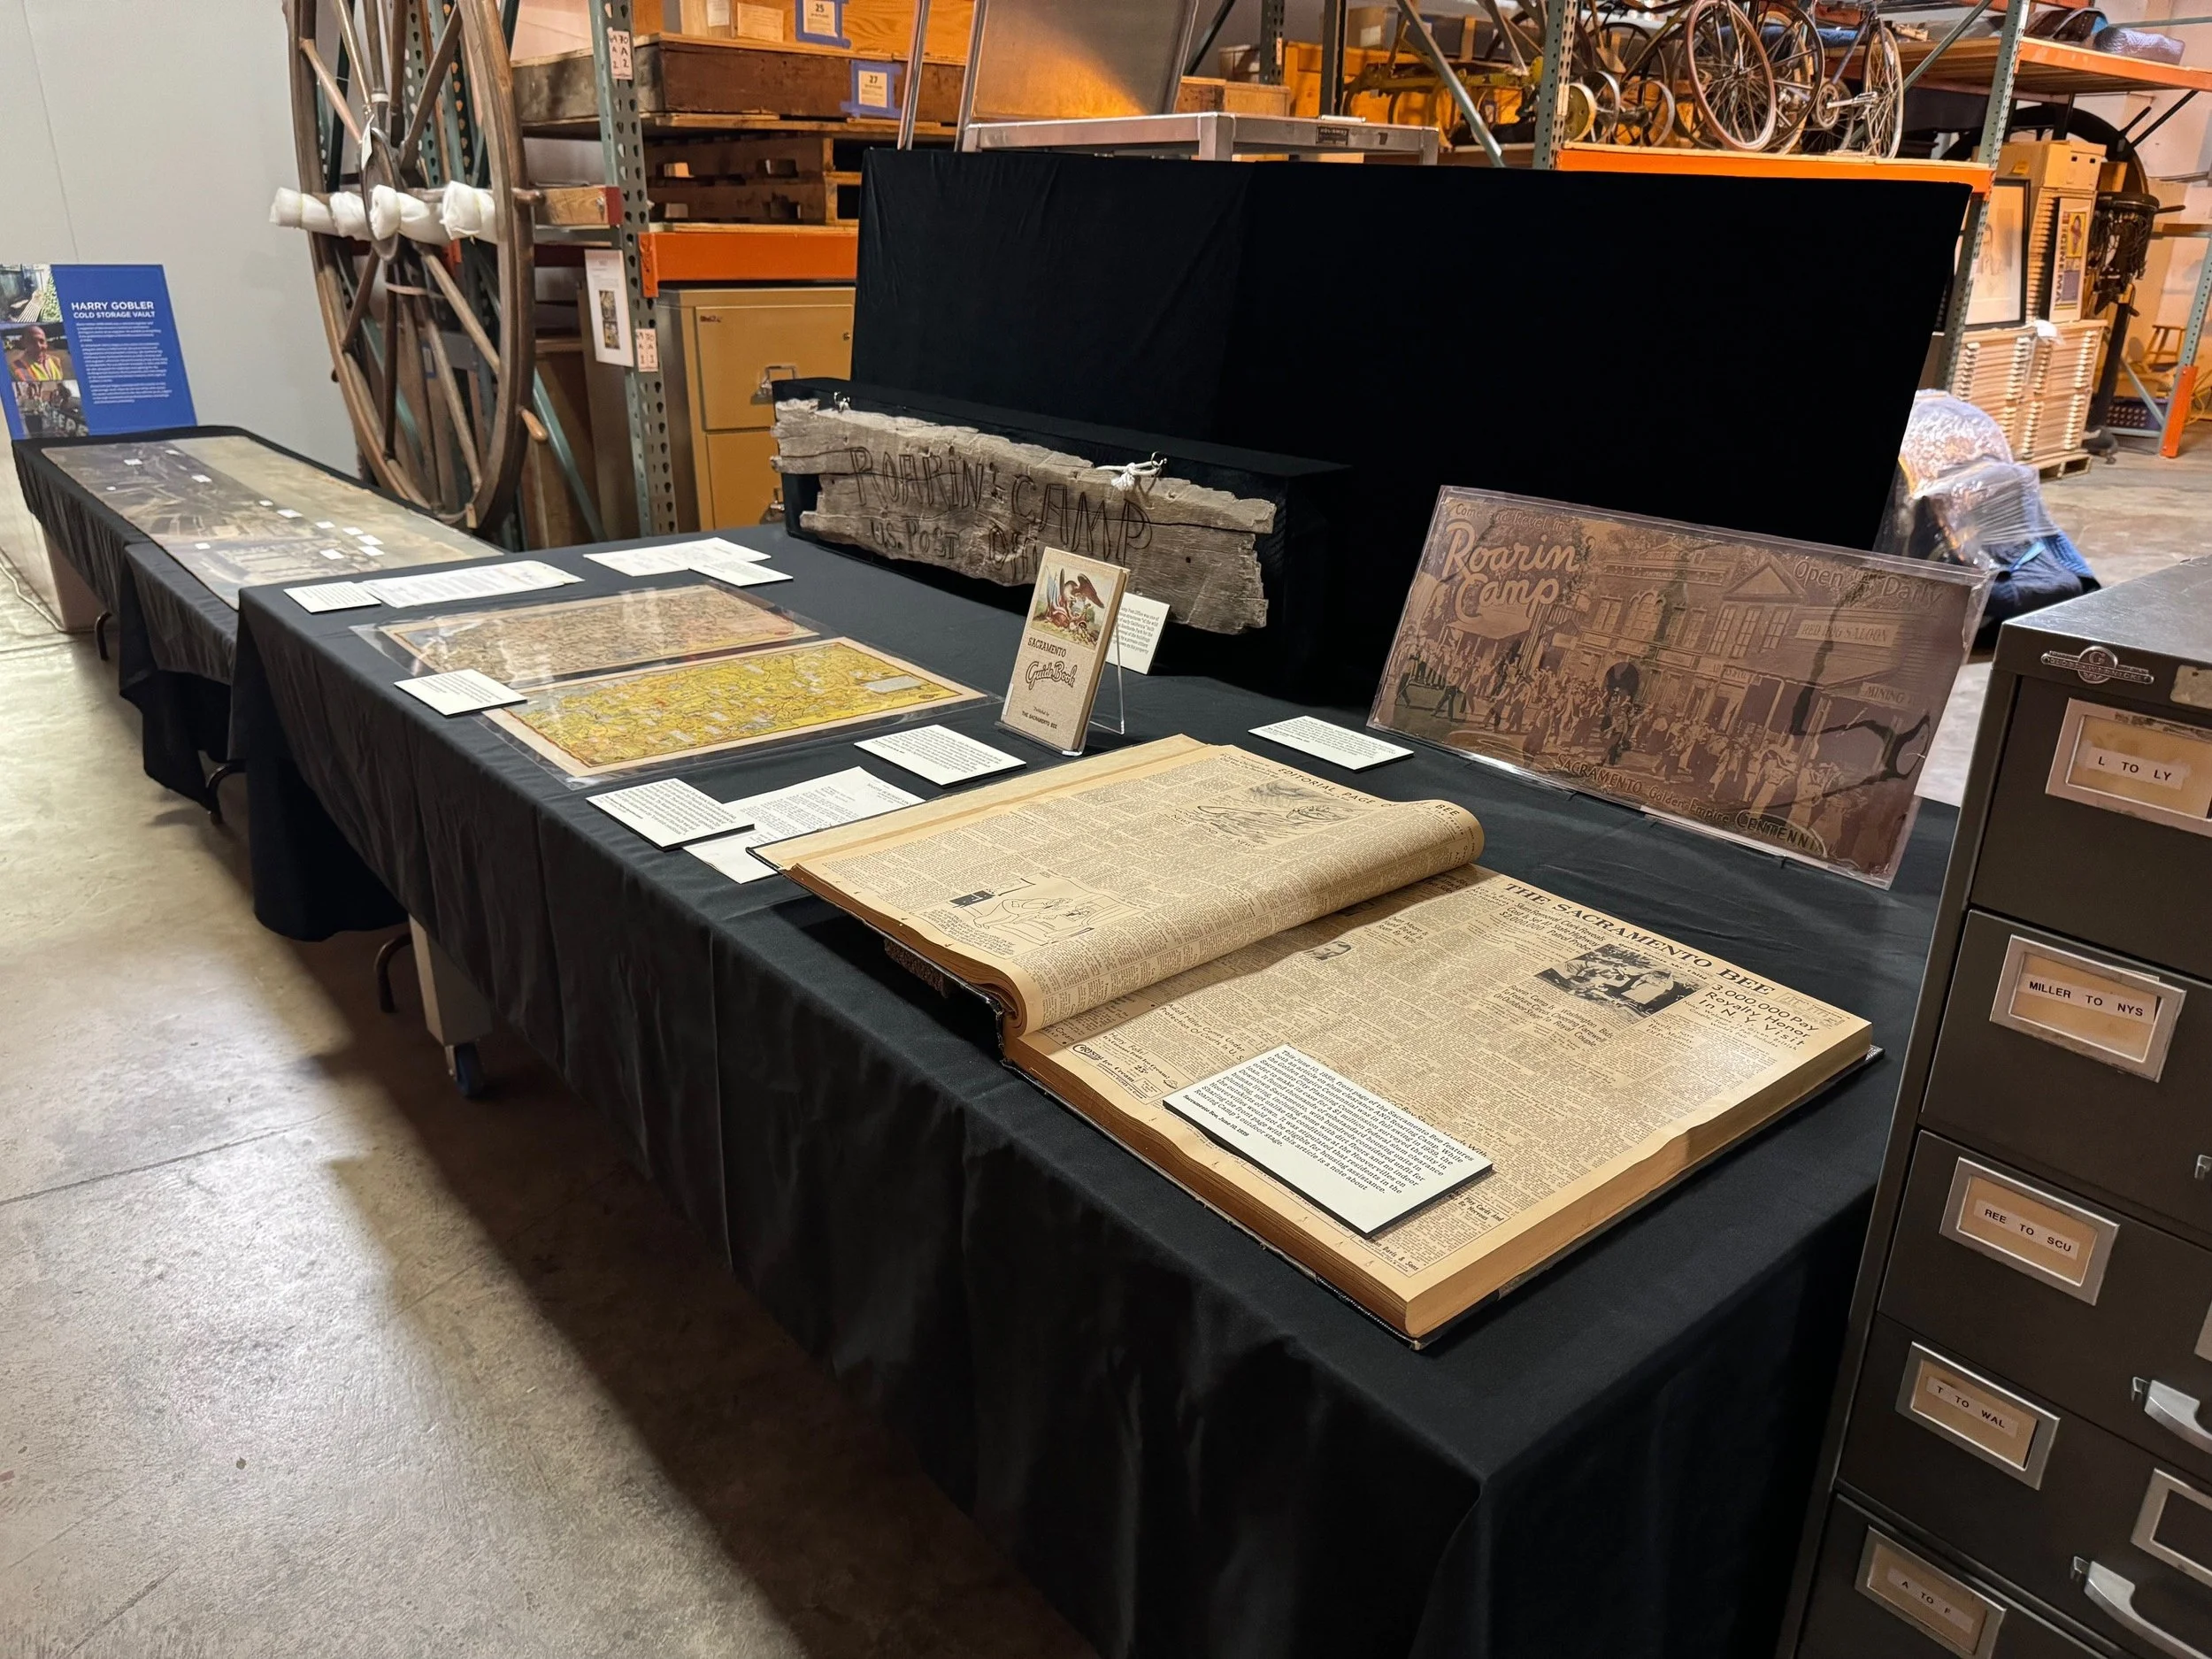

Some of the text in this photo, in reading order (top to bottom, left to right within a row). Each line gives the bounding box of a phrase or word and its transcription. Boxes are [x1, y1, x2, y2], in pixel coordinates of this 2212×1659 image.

[111, 301, 154, 310] GOBLER
[1011, 474, 1153, 565] CAMP
[1455, 503, 1483, 518] Come
[1513, 511, 1548, 531] Revel
[1552, 517, 1565, 531] in
[906, 519, 959, 559] POST
[1793, 560, 1844, 588] Open
[1882, 576, 1943, 604] Daily
[1455, 572, 1560, 624] Camp
[1027, 637, 1066, 657] SACRAMENTO
[1865, 687, 1904, 703] MINING
[1029, 714, 1049, 726] SACRAMENTO
[2098, 757, 2172, 781] L TO LY
[1278, 768, 1336, 793] EDITORIAL
[1341, 792, 1376, 804] PAGE
[1435, 803, 1460, 816] BEE
[1555, 753, 1827, 856] SACRAMENTO Golden Empire CENTENNI
[1507, 907, 1524, 917] Cost
[1515, 902, 1563, 923] Slum Removal
[1504, 883, 1550, 904] THE
[1552, 903, 1712, 967] SACRAMENTO
[1717, 968, 1775, 995] BEE
[1547, 929, 1592, 950] Patrol Probe
[1551, 924, 1600, 947] State Highway
[1561, 920, 1606, 941] Clark Reveals
[1502, 996, 1543, 1019] Outdoor Stage
[1509, 991, 1550, 1016] Feature Circus
[1531, 995, 1548, 1007] Camp
[1711, 984, 1791, 1018] 3,000,000
[1791, 1016, 1819, 1032] Pay
[2029, 980, 2144, 1018] MILLER TO NYS
[1160, 1007, 1189, 1029] Protection
[1201, 1033, 1221, 1046] Courts
[1168, 1003, 1245, 1052] Adolf Hitler Comes Under
[1550, 1012, 1608, 1043] Cheering Farewell
[1561, 1009, 1613, 1039] Washington Bids
[1699, 999, 1805, 1046] In N. Y. Visit
[1705, 991, 1761, 1017] Royalty
[1764, 1016, 1811, 1038] Honor
[1056, 1027, 1075, 1041] Cream
[1109, 1033, 1148, 1055] Hurry Folks!
[1553, 1021, 1597, 1047] Royal Couple
[1115, 1066, 1134, 1082] Cream
[1259, 1059, 1439, 1164] Sacramento City Planning Commission surveyed the city
[1273, 1053, 1464, 1163] both article slum clearance AND Roaring Camp. While
[1277, 1062, 1301, 1075] Golden
[1296, 1074, 1323, 1089] Empire
[1320, 1087, 1358, 1109] Centennial
[1356, 1108, 1371, 1117] was
[1378, 1120, 1393, 1129] full
[1388, 1127, 1414, 1141] swing
[1418, 1145, 1441, 1157] 1939,
[1439, 1156, 1454, 1164] the
[1294, 1057, 1310, 1067] June
[1317, 1071, 1338, 1082] 1939,
[1335, 1081, 1354, 1092] front
[1350, 1091, 1369, 1102] page
[1386, 1110, 1430, 1135] Sacramento
[1427, 1134, 1444, 1143] Bee
[1441, 1142, 1475, 1161] features
[1468, 1143, 1487, 1157] With
[1463, 1196, 1476, 1205] Play
[1476, 1204, 1492, 1215] Cards
[1467, 1207, 1488, 1220] Nervous
[1983, 1207, 2072, 1253] REE TO SCU
[1405, 1261, 1419, 1271] Sons
[1936, 1385, 2006, 1429] T TO WAL
[1921, 1592, 1933, 1603] TO
